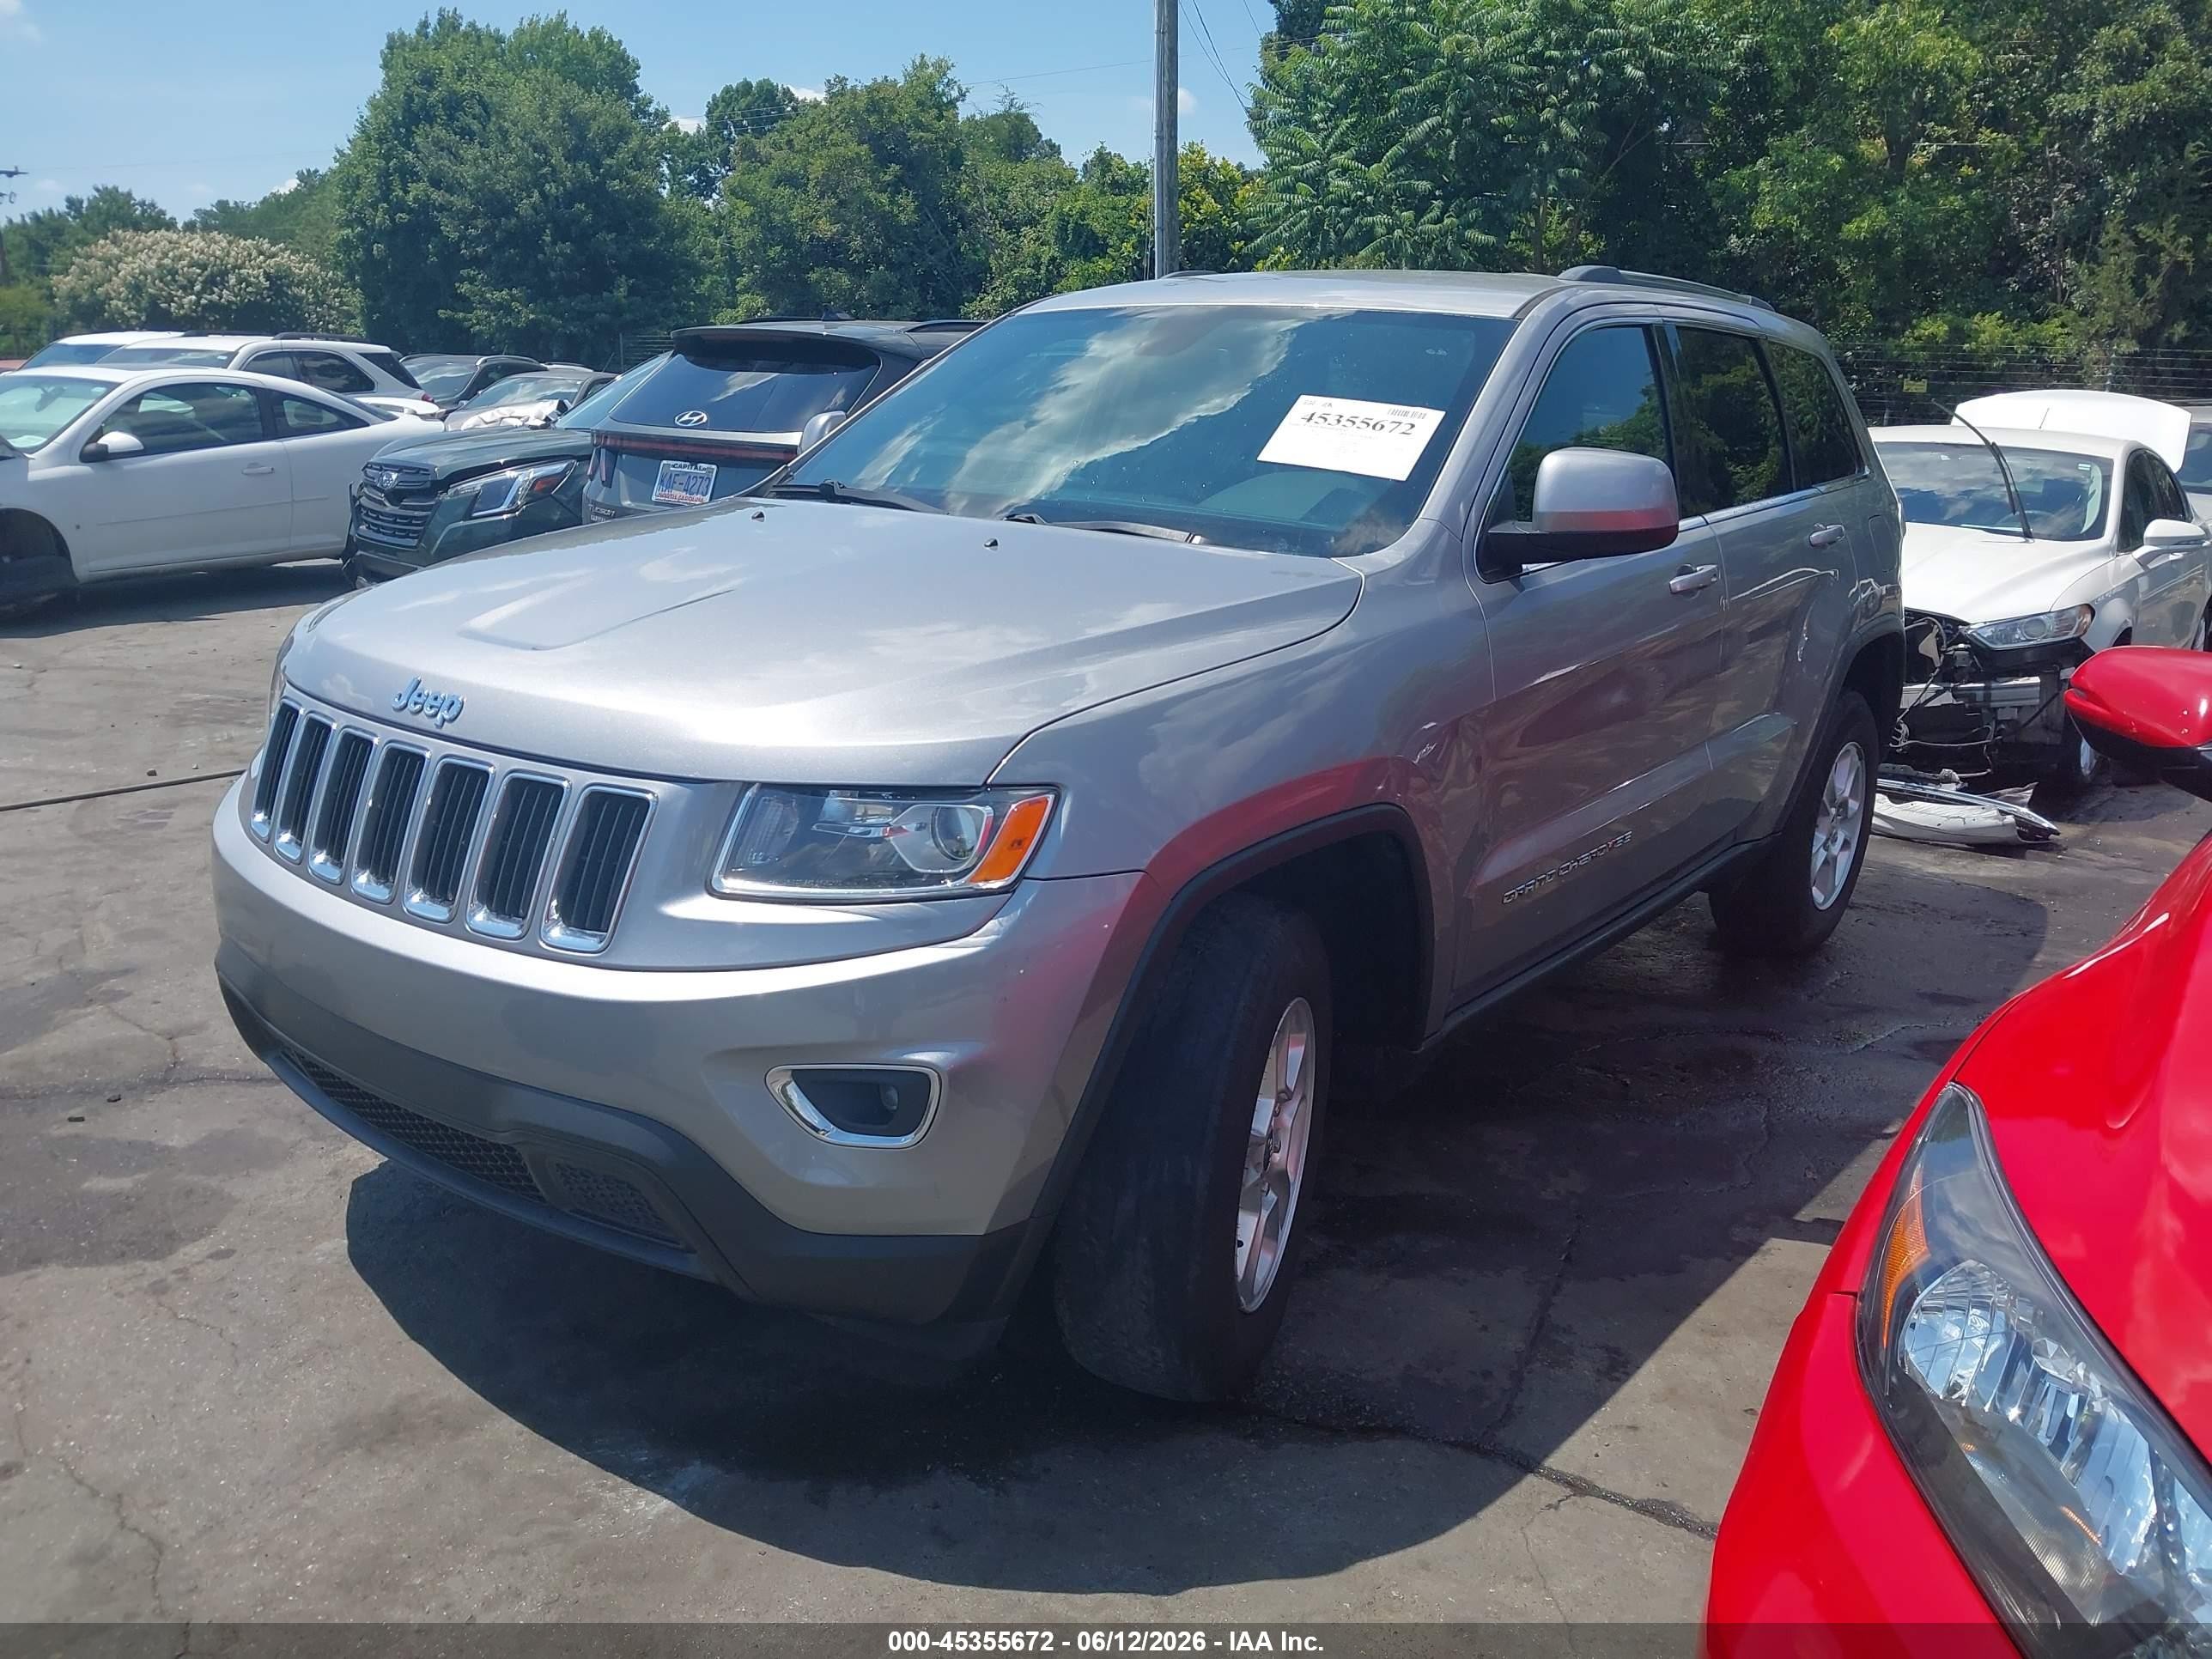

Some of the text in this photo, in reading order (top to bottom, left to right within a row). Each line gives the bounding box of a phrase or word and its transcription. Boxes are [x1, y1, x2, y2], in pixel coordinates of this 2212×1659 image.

[1301, 411, 1416, 434] 45355672
[391, 675, 465, 729] Jeep
[1502, 830, 1632, 904] GRAND CHEROKEE
